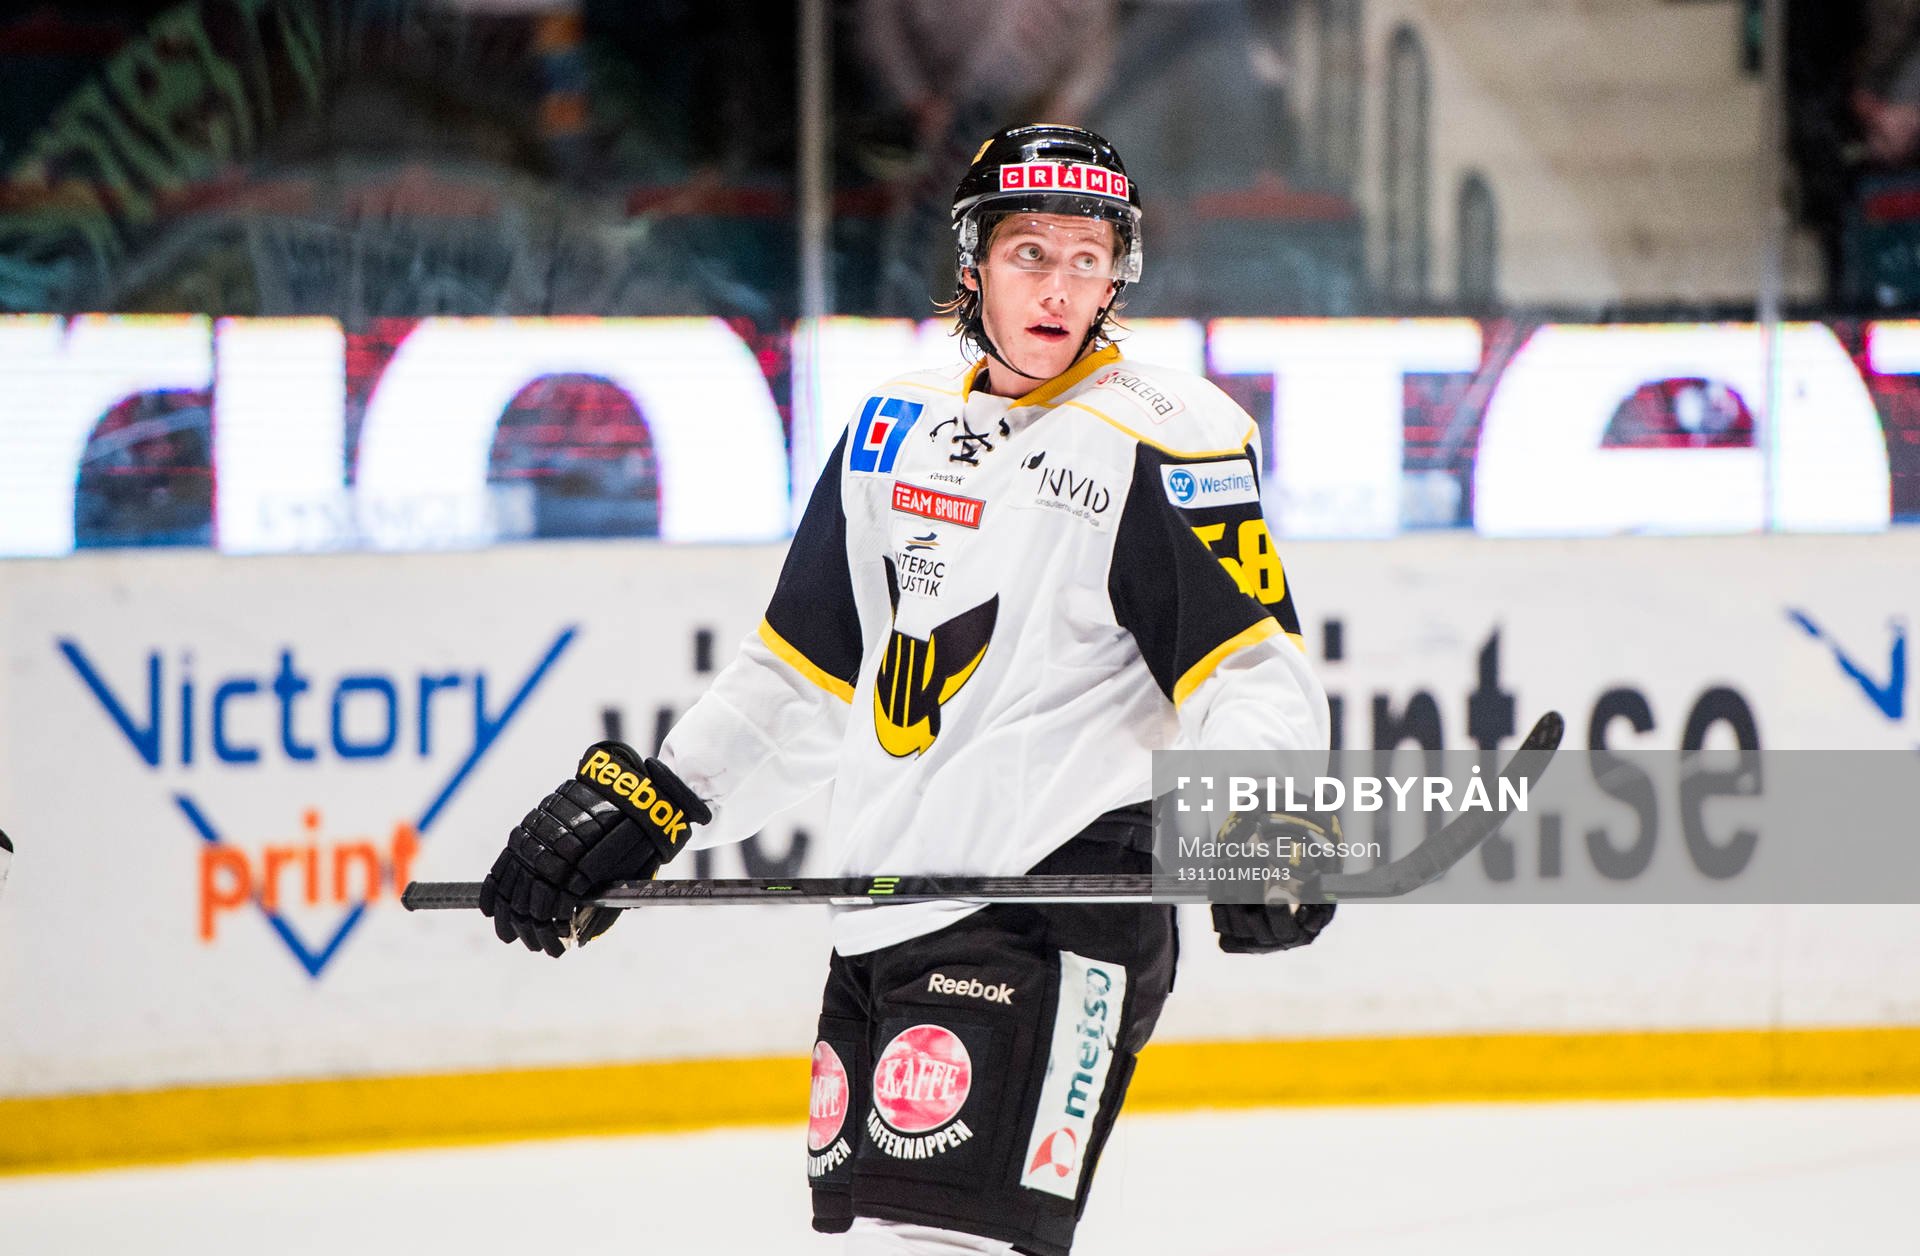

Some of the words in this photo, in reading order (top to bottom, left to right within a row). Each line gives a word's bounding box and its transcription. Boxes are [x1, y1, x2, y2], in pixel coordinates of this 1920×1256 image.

[1006, 168, 1125, 194] CRAMO
[895, 486, 932, 513] TEAM
[935, 497, 975, 523] SPORTIA
[57, 622, 580, 770] Victory
[580, 749, 688, 845] Reebok
[199, 808, 419, 944] print
[927, 973, 1015, 1005] Reebok
[810, 1075, 841, 1118] AFFE
[879, 1056, 960, 1101] KAFFE
[866, 1107, 974, 1160] KAFFEKNAPPEN
[808, 1136, 852, 1178] NAPPEN
